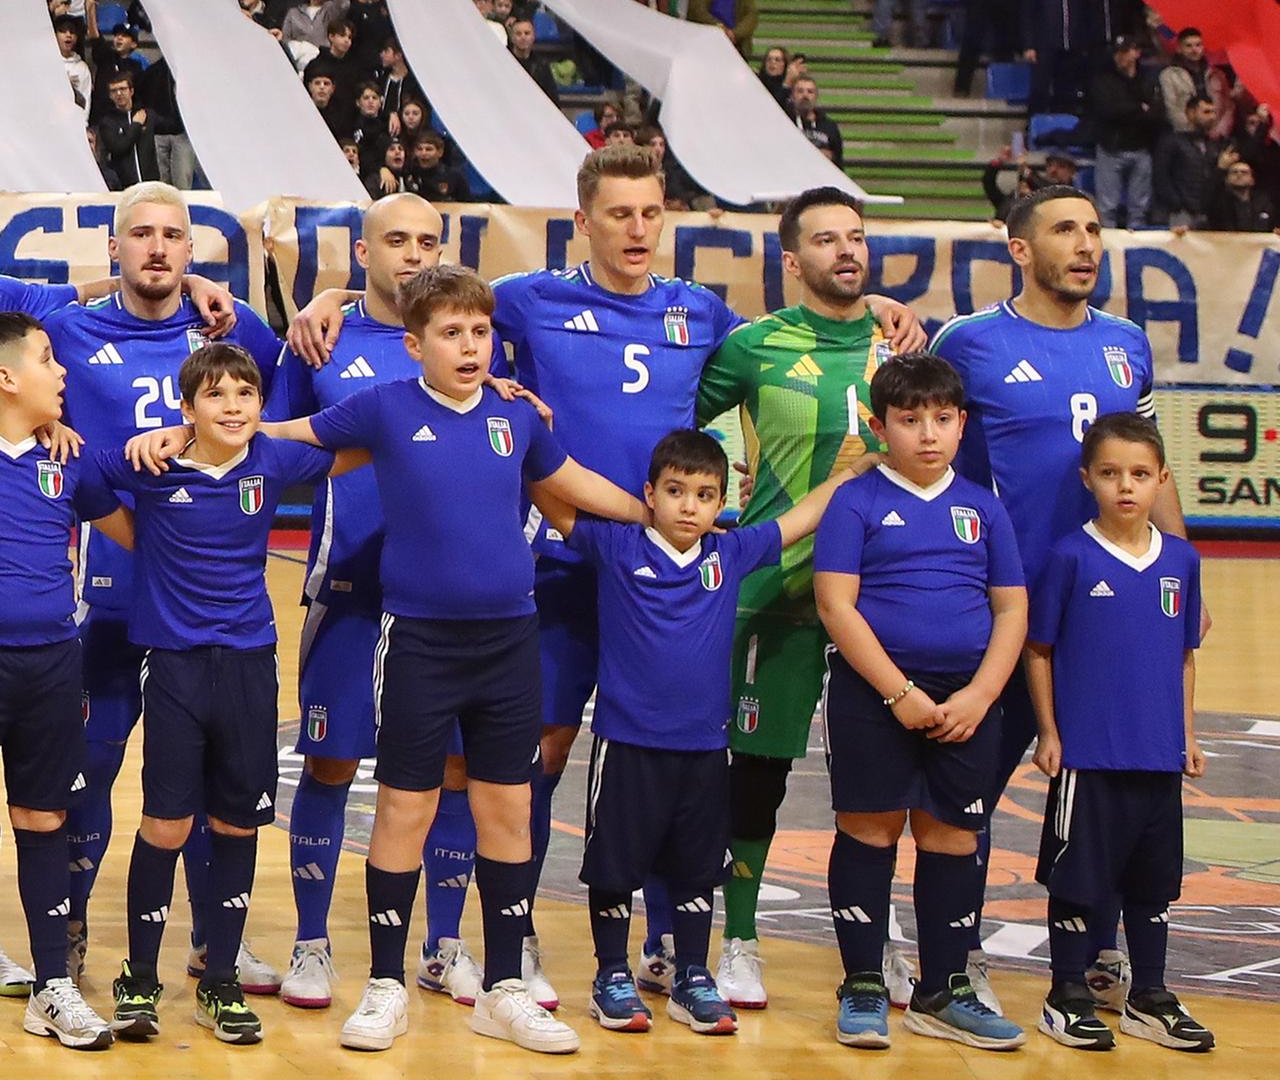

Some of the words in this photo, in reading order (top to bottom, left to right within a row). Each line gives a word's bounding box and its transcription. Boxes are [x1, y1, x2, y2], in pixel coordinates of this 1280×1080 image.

[621, 343, 651, 394] 5
[1070, 393, 1098, 443] 8
[242, 478, 261, 488] ITALIA
